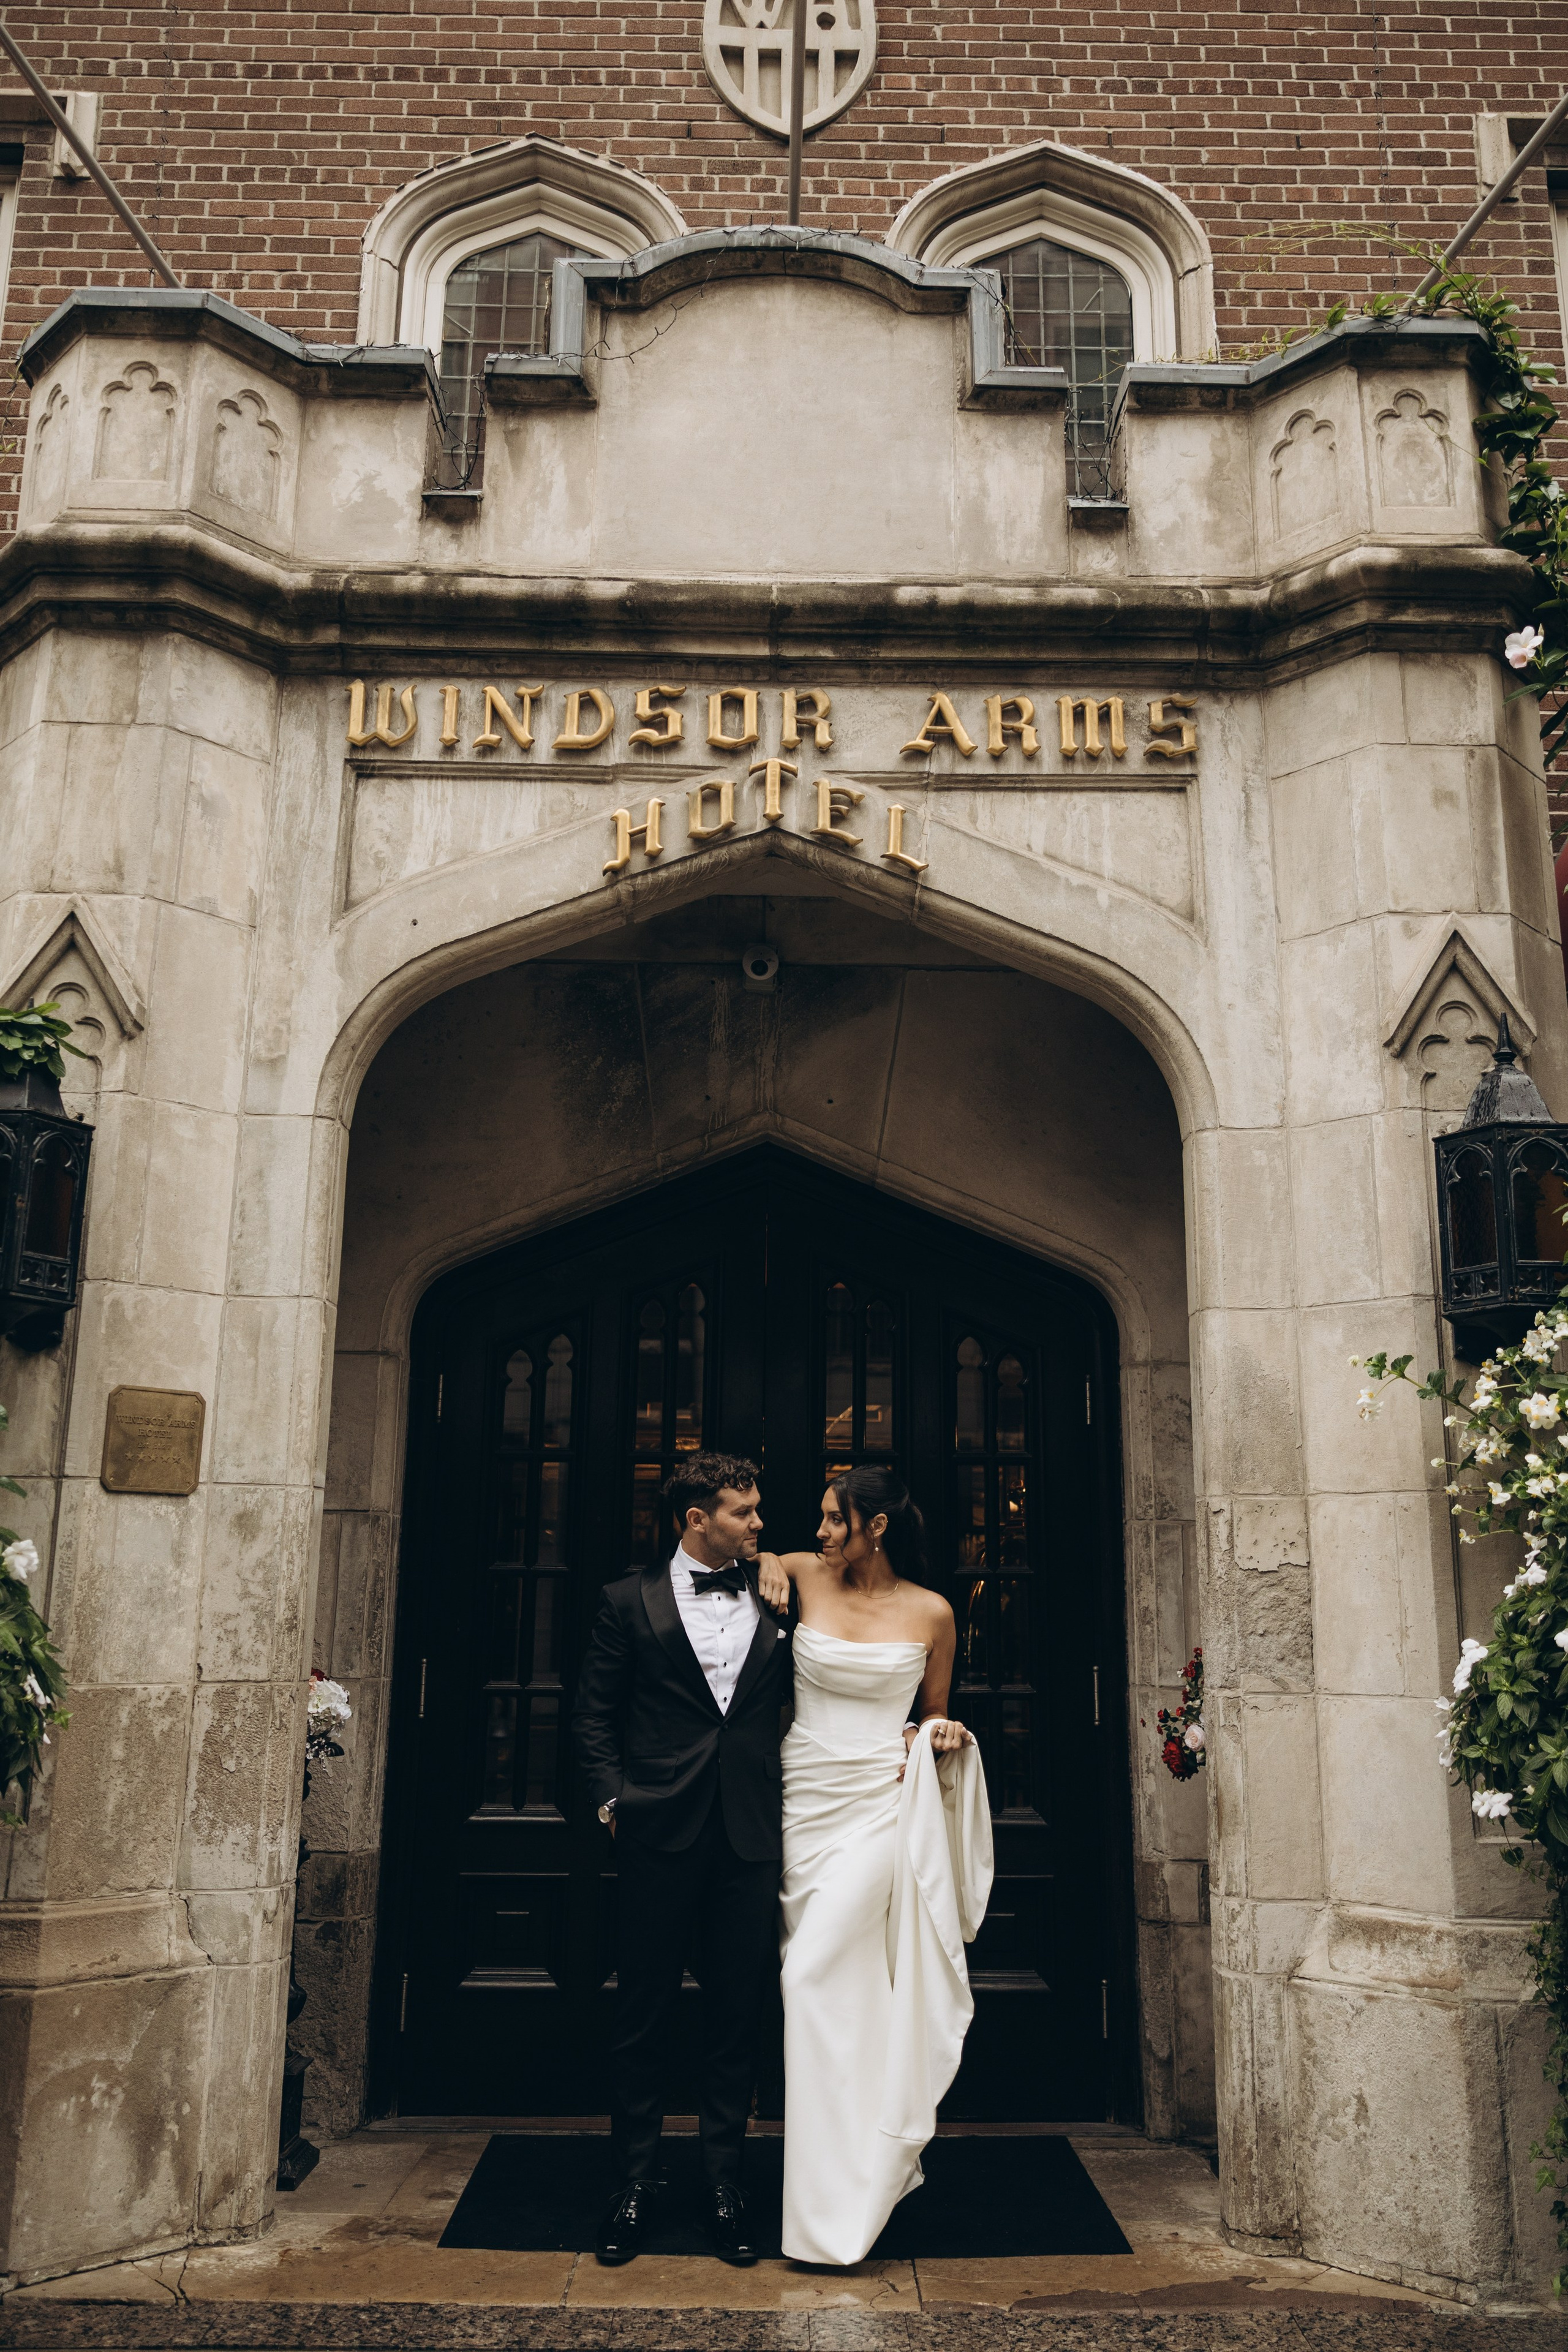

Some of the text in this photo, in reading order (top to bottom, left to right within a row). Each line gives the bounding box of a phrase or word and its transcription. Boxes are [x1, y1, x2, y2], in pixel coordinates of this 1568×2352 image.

[345, 679, 1200, 758] WINDSOR ARMS
[602, 757, 929, 874] HOTEL
[115, 1415, 196, 1429] WINDSOR ARMS
[138, 1428, 172, 1439] HOTEL
